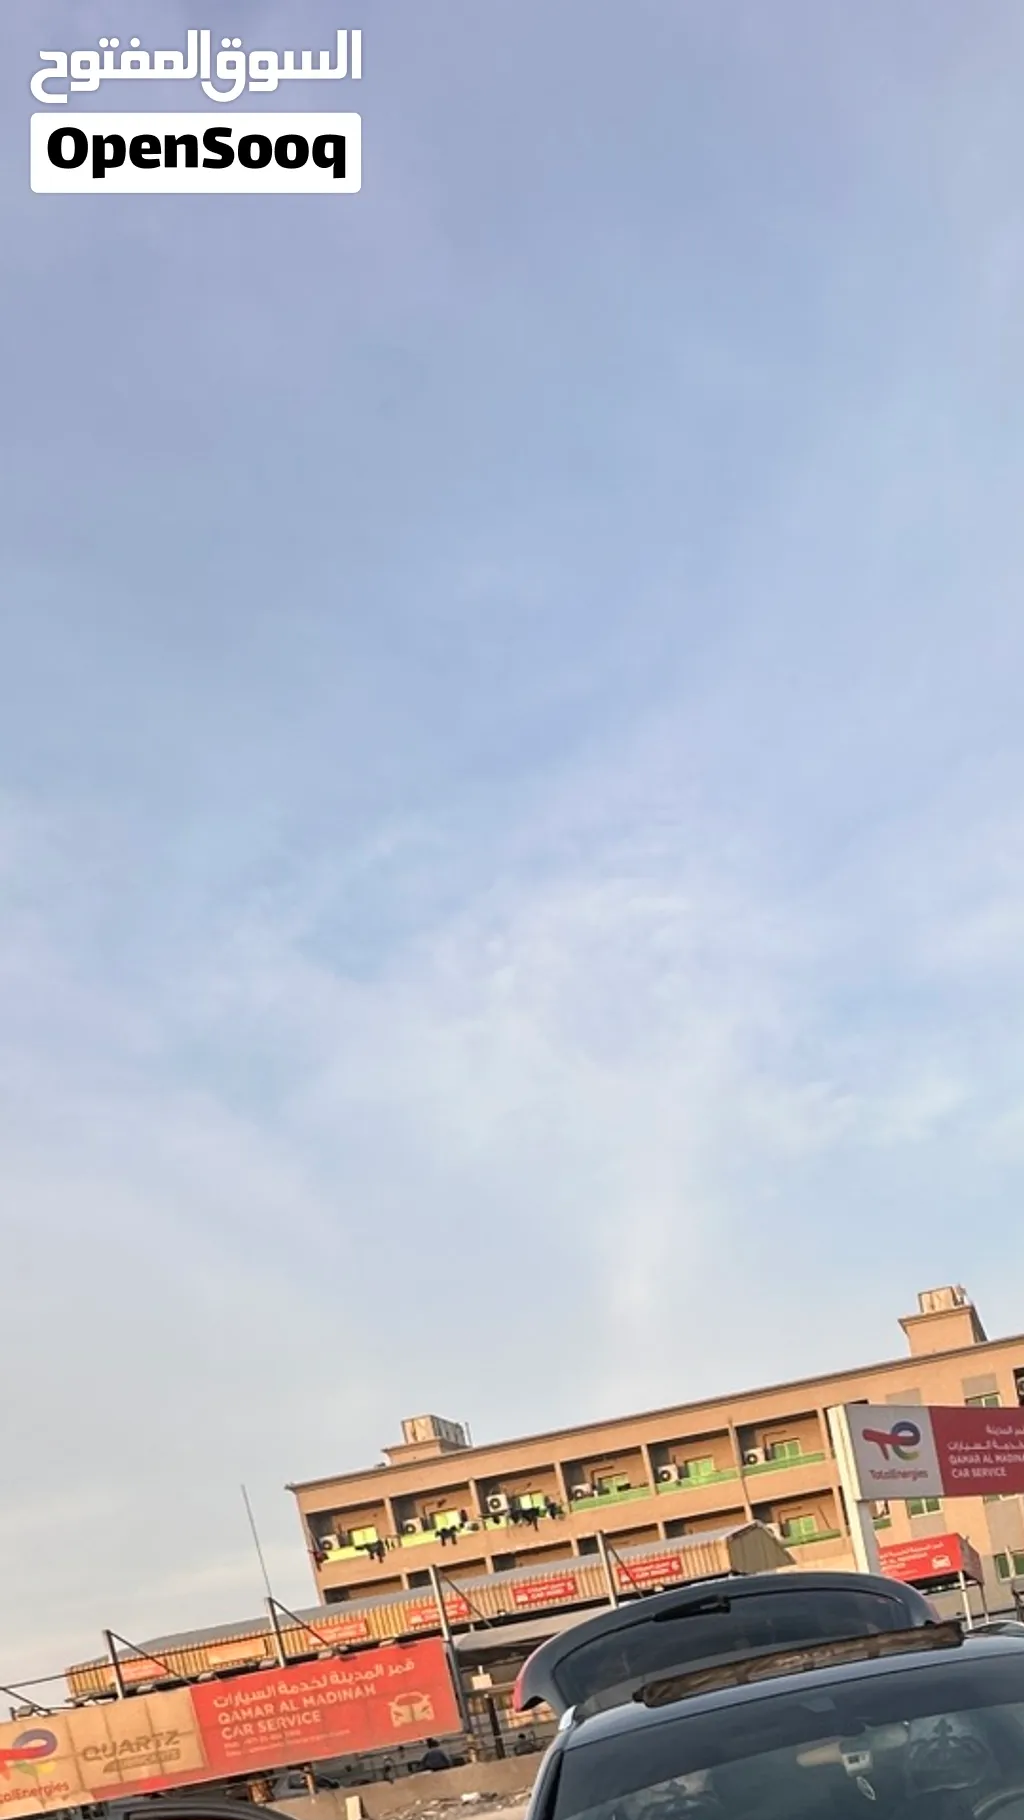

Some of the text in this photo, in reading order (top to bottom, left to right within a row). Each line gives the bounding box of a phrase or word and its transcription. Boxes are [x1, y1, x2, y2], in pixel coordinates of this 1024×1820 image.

[868, 1467, 929, 1482] TotalEnergies
[951, 1466, 1008, 1479] CAR SERVICE
[213, 1658, 415, 1709] قمر المدينة لخدمة السيارات
[217, 1683, 377, 1725] QAMAR AL MADINAH
[221, 1721, 254, 1741] CAR
[257, 1710, 321, 1733] SERVICE
[82, 1730, 181, 1762] QUARTZ
